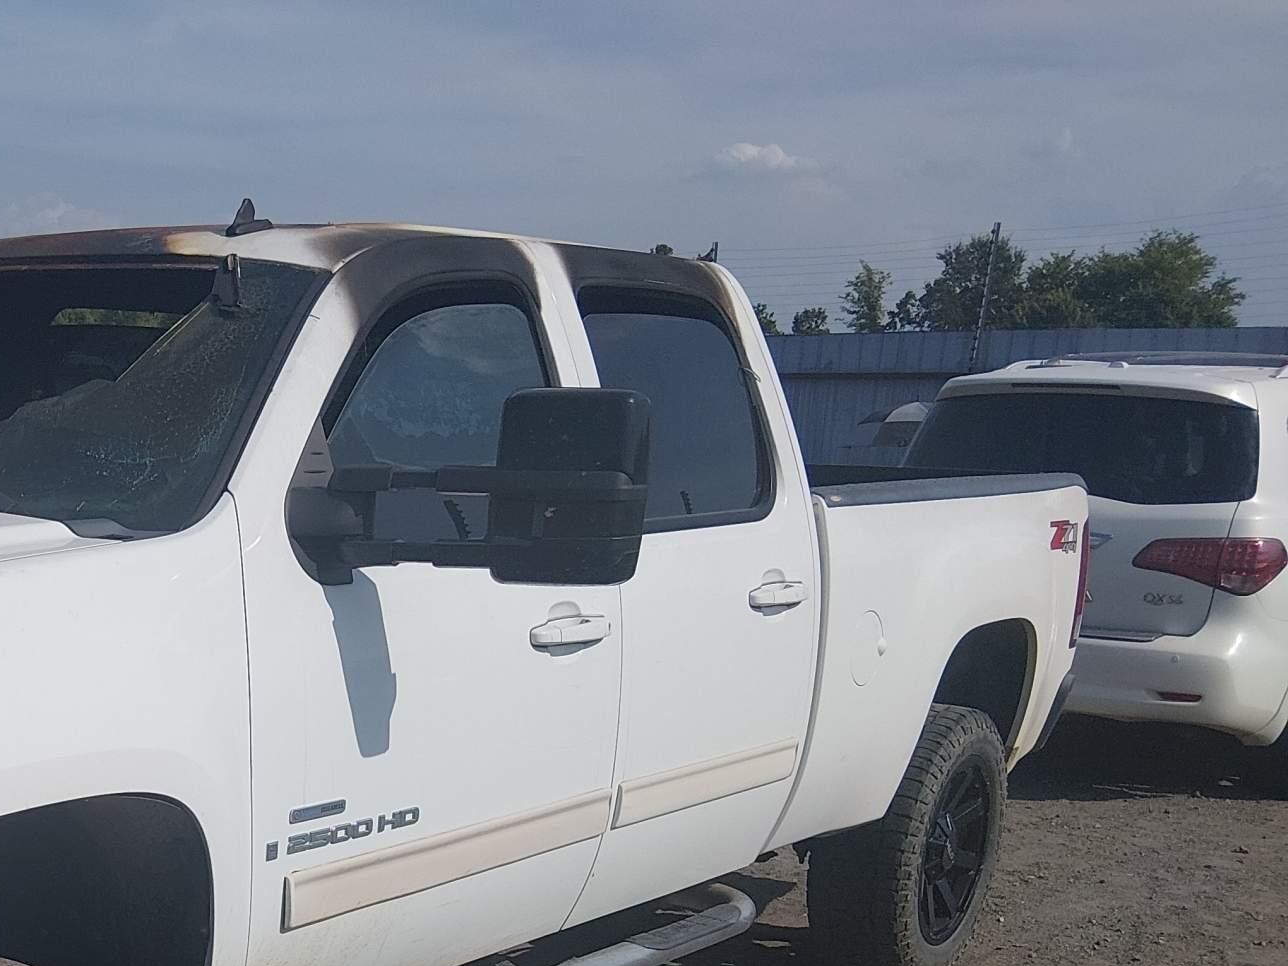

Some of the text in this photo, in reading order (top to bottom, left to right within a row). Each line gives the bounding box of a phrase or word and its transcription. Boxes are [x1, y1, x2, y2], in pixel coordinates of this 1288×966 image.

[1049, 519, 1078, 550] Z71
[286, 817, 373, 855] 2500
[377, 806, 420, 833] HD
